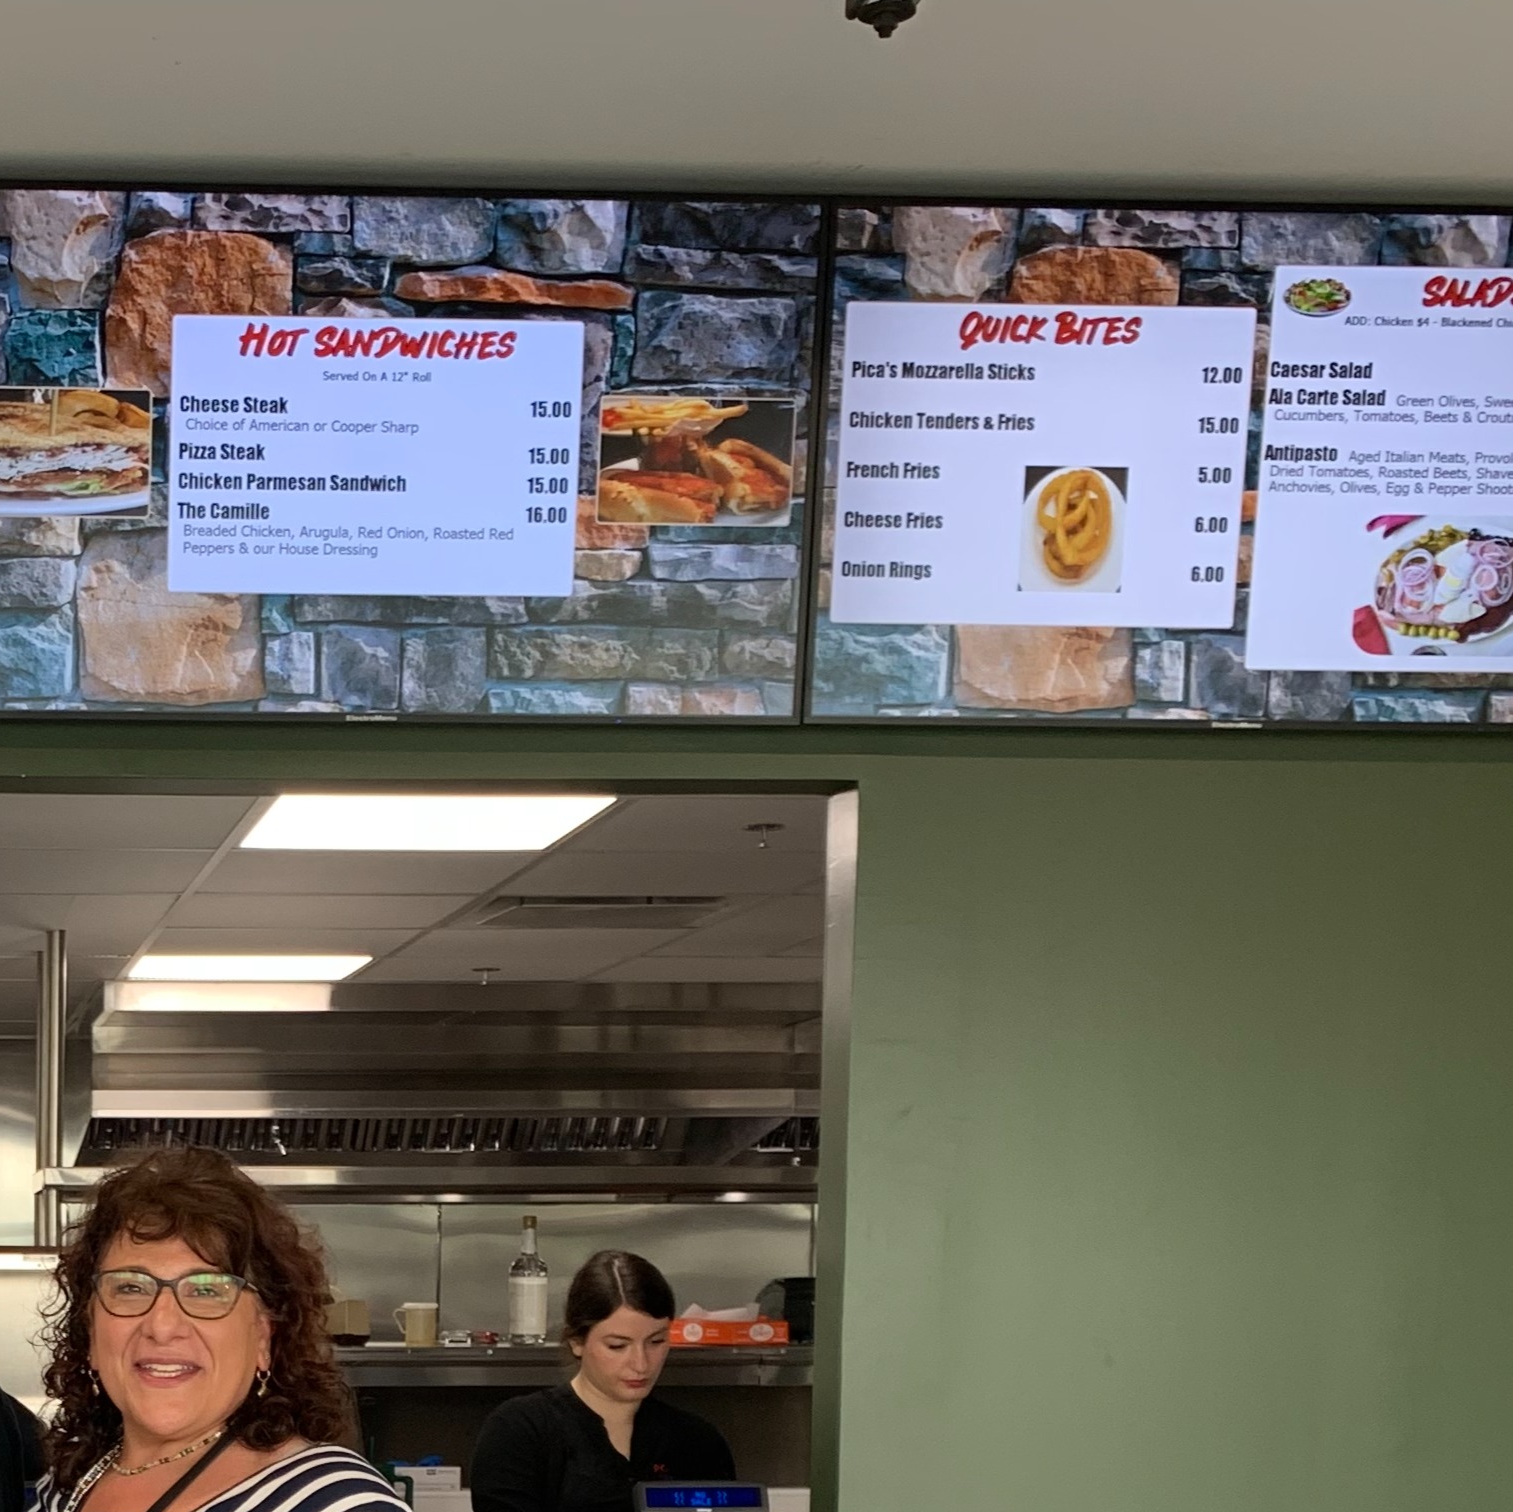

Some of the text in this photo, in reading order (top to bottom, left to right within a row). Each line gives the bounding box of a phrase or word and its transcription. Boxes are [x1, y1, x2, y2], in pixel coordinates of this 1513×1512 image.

[1422, 276, 1513, 308] SALAD
[323, 371, 359, 381] Served
[363, 372, 377, 382] On
[413, 372, 432, 382] Roll
[851, 361, 1035, 380] Pica's Mozzarella Sticks
[1202, 367, 1243, 384] 12.00
[1271, 361, 1373, 379] Caesar Salad
[180, 396, 288, 414] Cheese Steak
[1297, 389, 1339, 405] Carte
[1342, 389, 1386, 406] Salad
[1396, 394, 1479, 410] Green Olives,
[531, 401, 572, 418] 15.00
[1275, 409, 1459, 425] Cucumbers, Tomatoes, Beets
[185, 418, 419, 436] Choice of American or Cooper Sharp
[849, 411, 1035, 431] Chicken Tenders Fries
[1199, 417, 1239, 434] 15.00
[179, 443, 265, 460] Pizza Steak
[529, 448, 570, 465] 15.00
[1264, 444, 1338, 463] Antipasto
[847, 461, 940, 479] French Fries
[1199, 467, 1232, 484] 5.00
[179, 472, 406, 492] Chicken Parmesan Sandwich
[527, 477, 568, 494] 15.00
[177, 502, 270, 520] The Camille
[526, 507, 567, 523] 16.00
[844, 511, 943, 529] Cheese Fries
[1195, 517, 1228, 533] 6.00
[183, 524, 514, 542] Breaded Chicken, Arugula, Red Onion, Roasted Red
[841, 561, 932, 580] Onion Rings
[1191, 566, 1224, 583] 6.00
